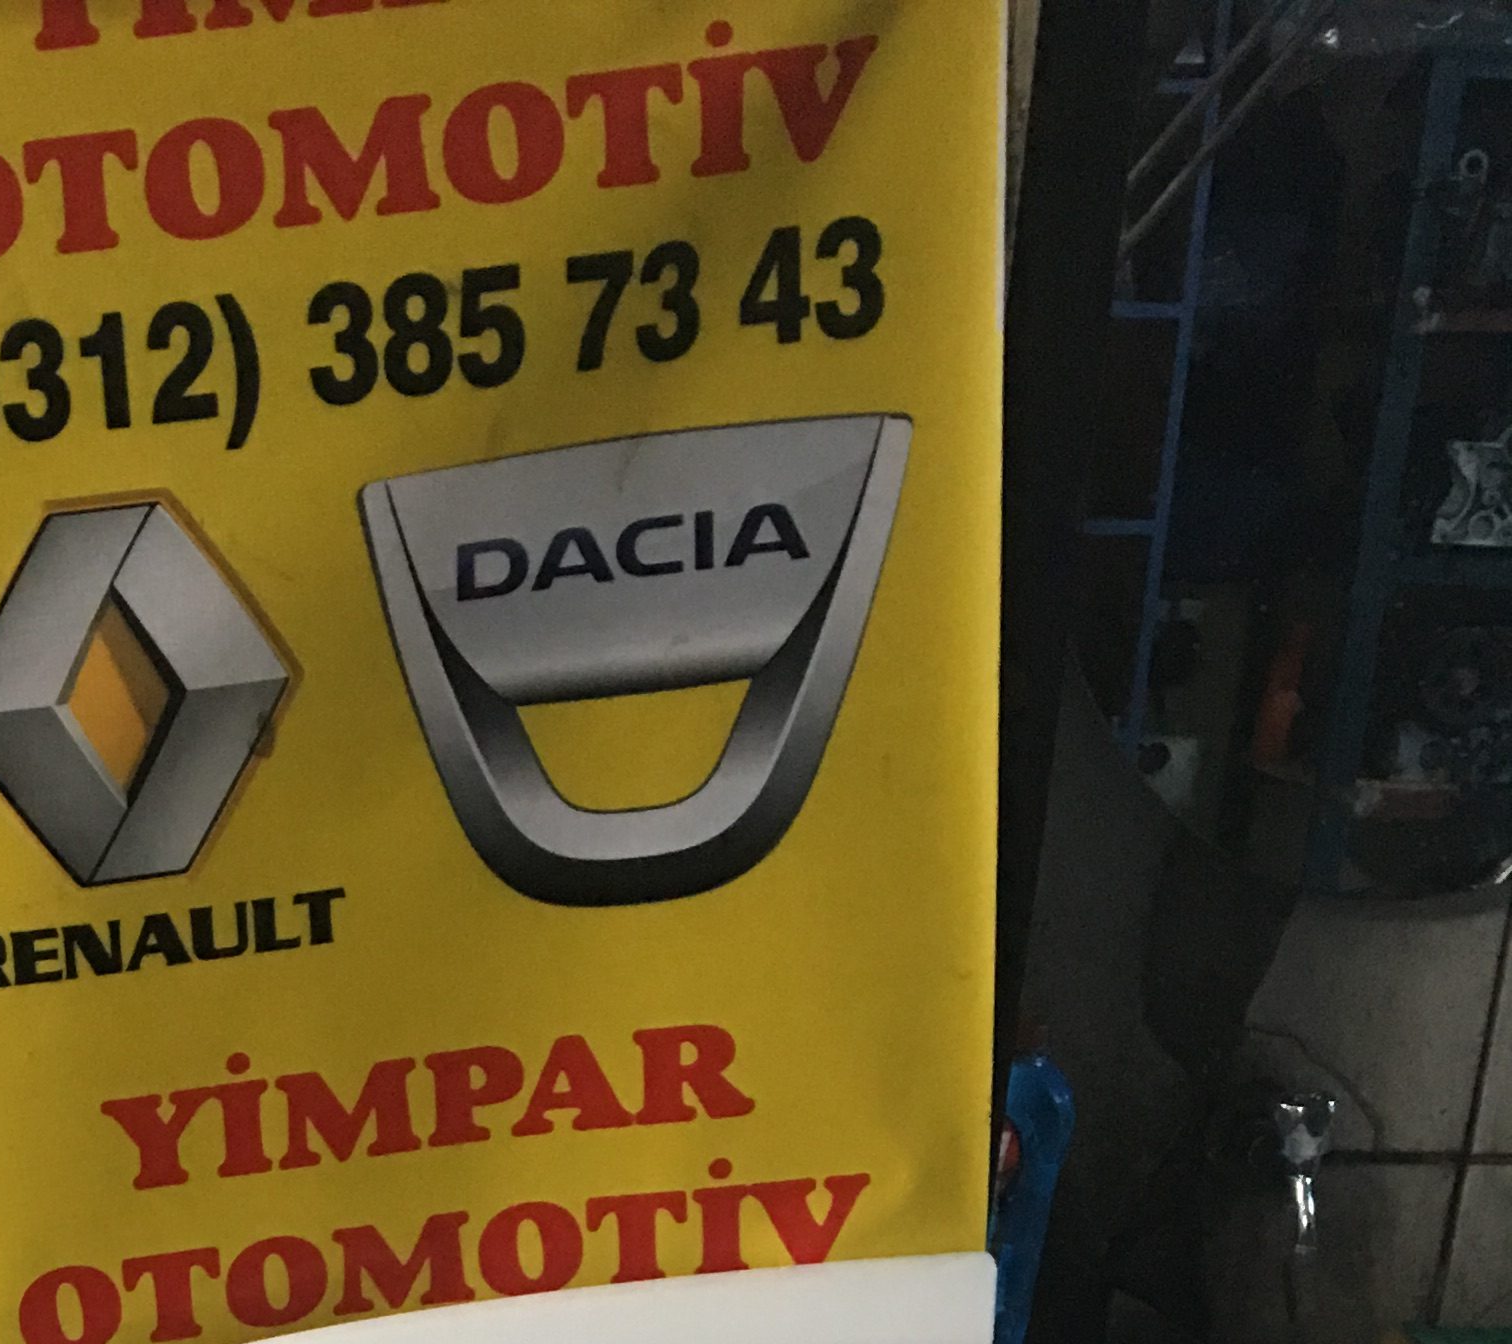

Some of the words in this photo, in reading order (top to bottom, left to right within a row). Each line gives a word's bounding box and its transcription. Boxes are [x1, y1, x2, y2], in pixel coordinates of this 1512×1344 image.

[306, 264, 525, 407] 385
[566, 241, 701, 372] 73
[739, 216, 886, 345] 43
[456, 502, 810, 602] DACIA
[100, 1023, 755, 1191] YİMPAR
